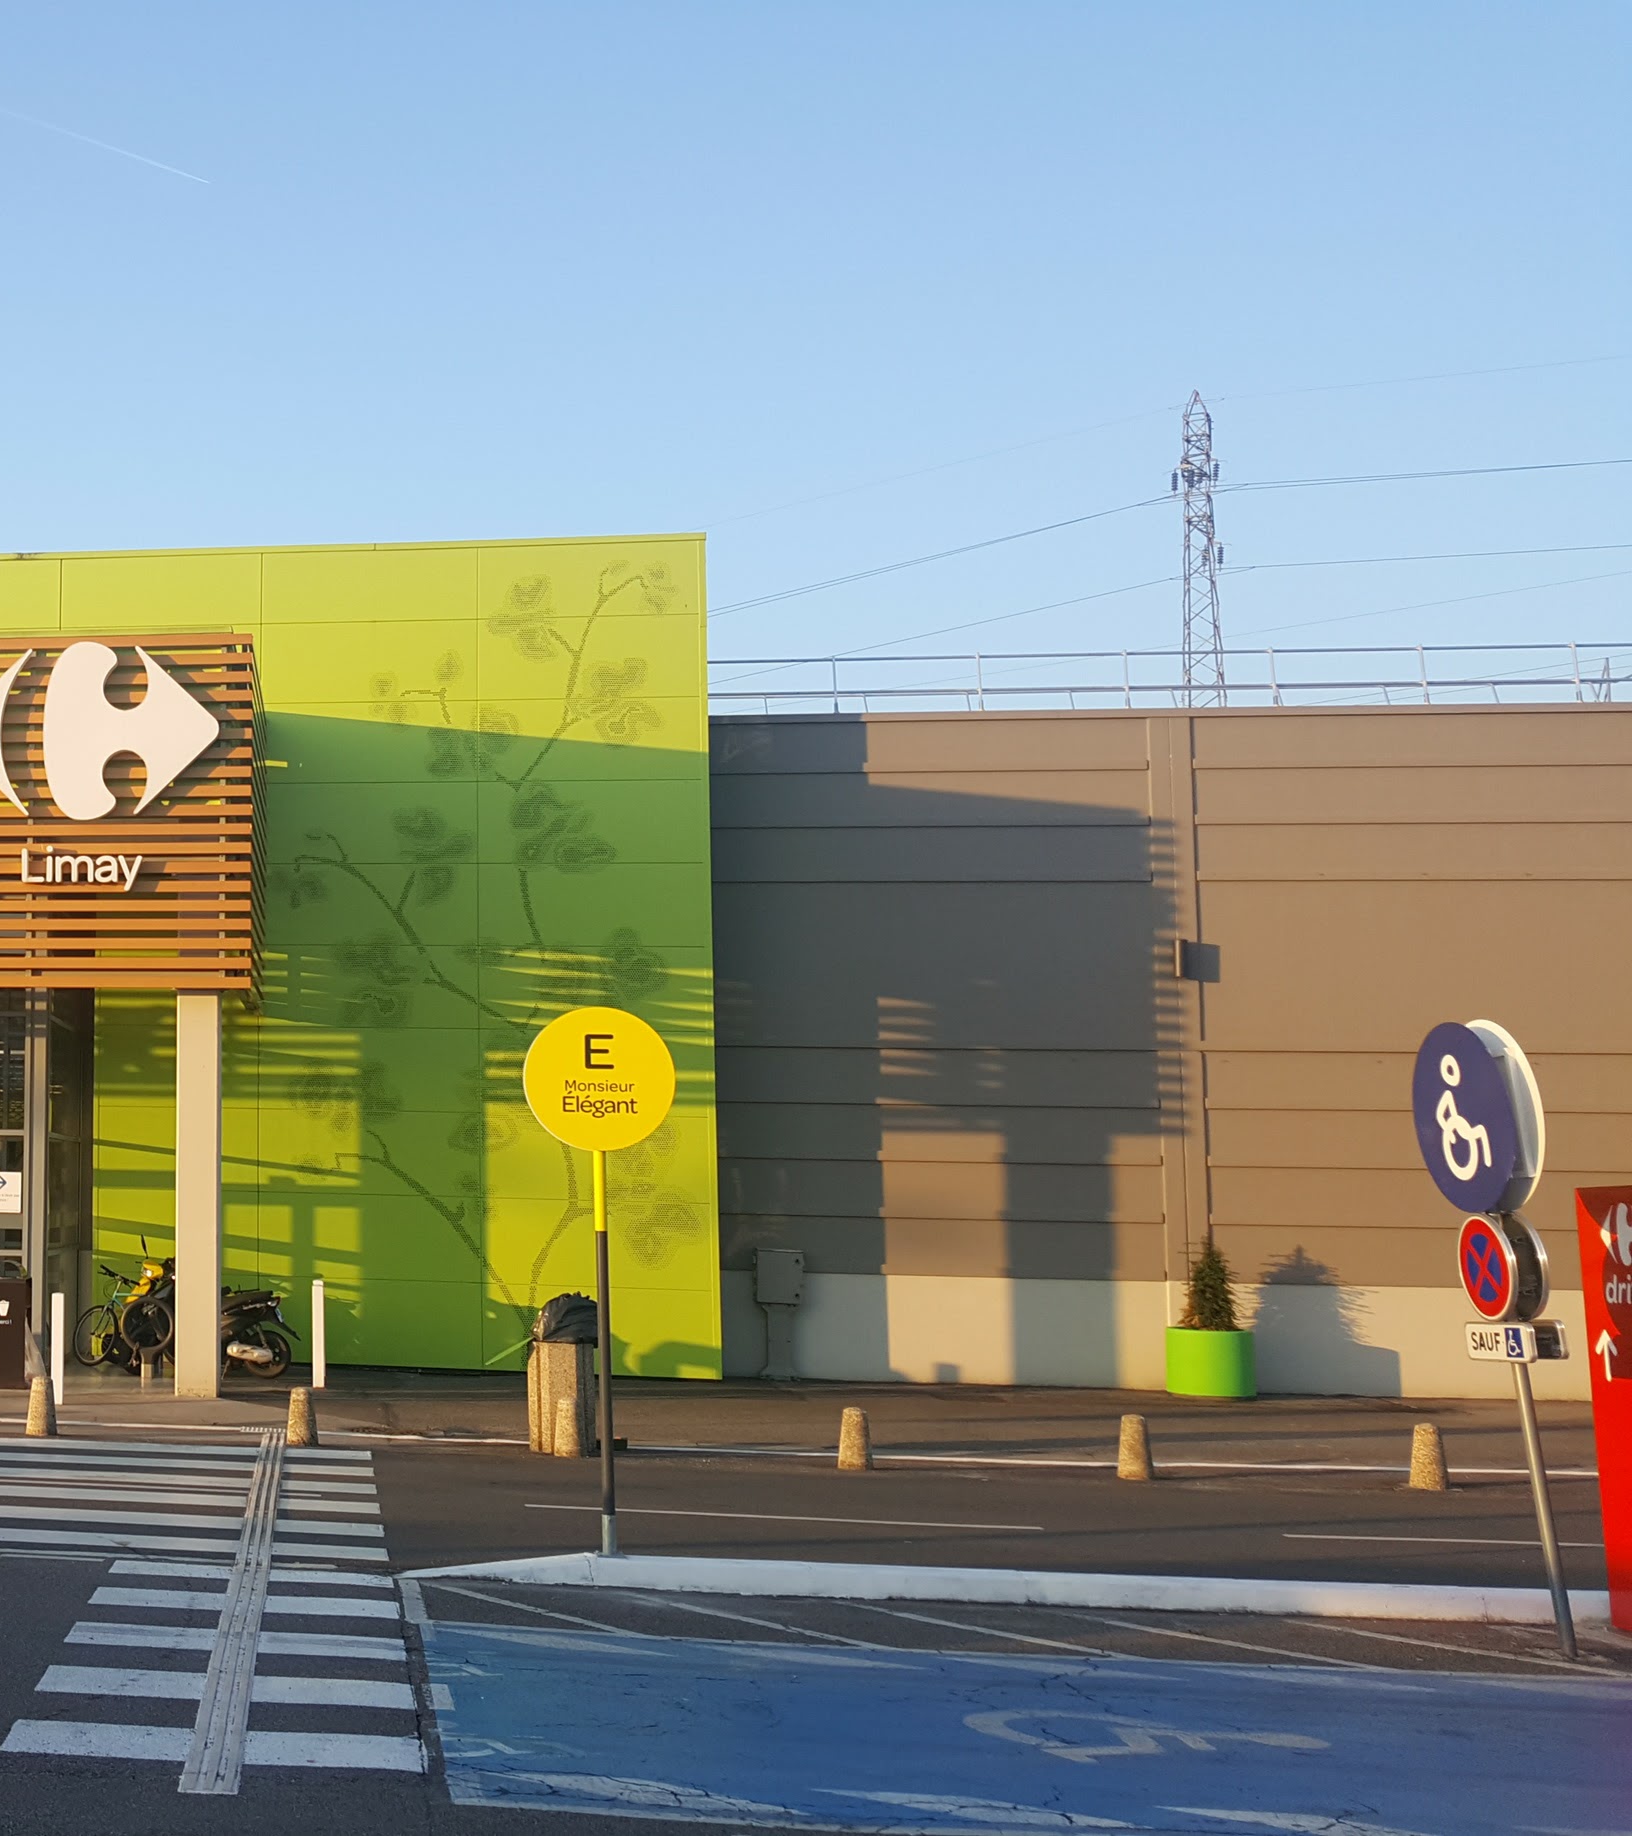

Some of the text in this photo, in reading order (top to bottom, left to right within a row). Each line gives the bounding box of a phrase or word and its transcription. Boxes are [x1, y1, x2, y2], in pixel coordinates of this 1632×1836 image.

[20, 845, 143, 891] Limay
[584, 1033, 615, 1070] E
[564, 1079, 635, 1093] Monsieur
[562, 1091, 638, 1118] Élégant
[1605, 1273, 1632, 1305] dri
[1470, 1331, 1501, 1352] SAUF
